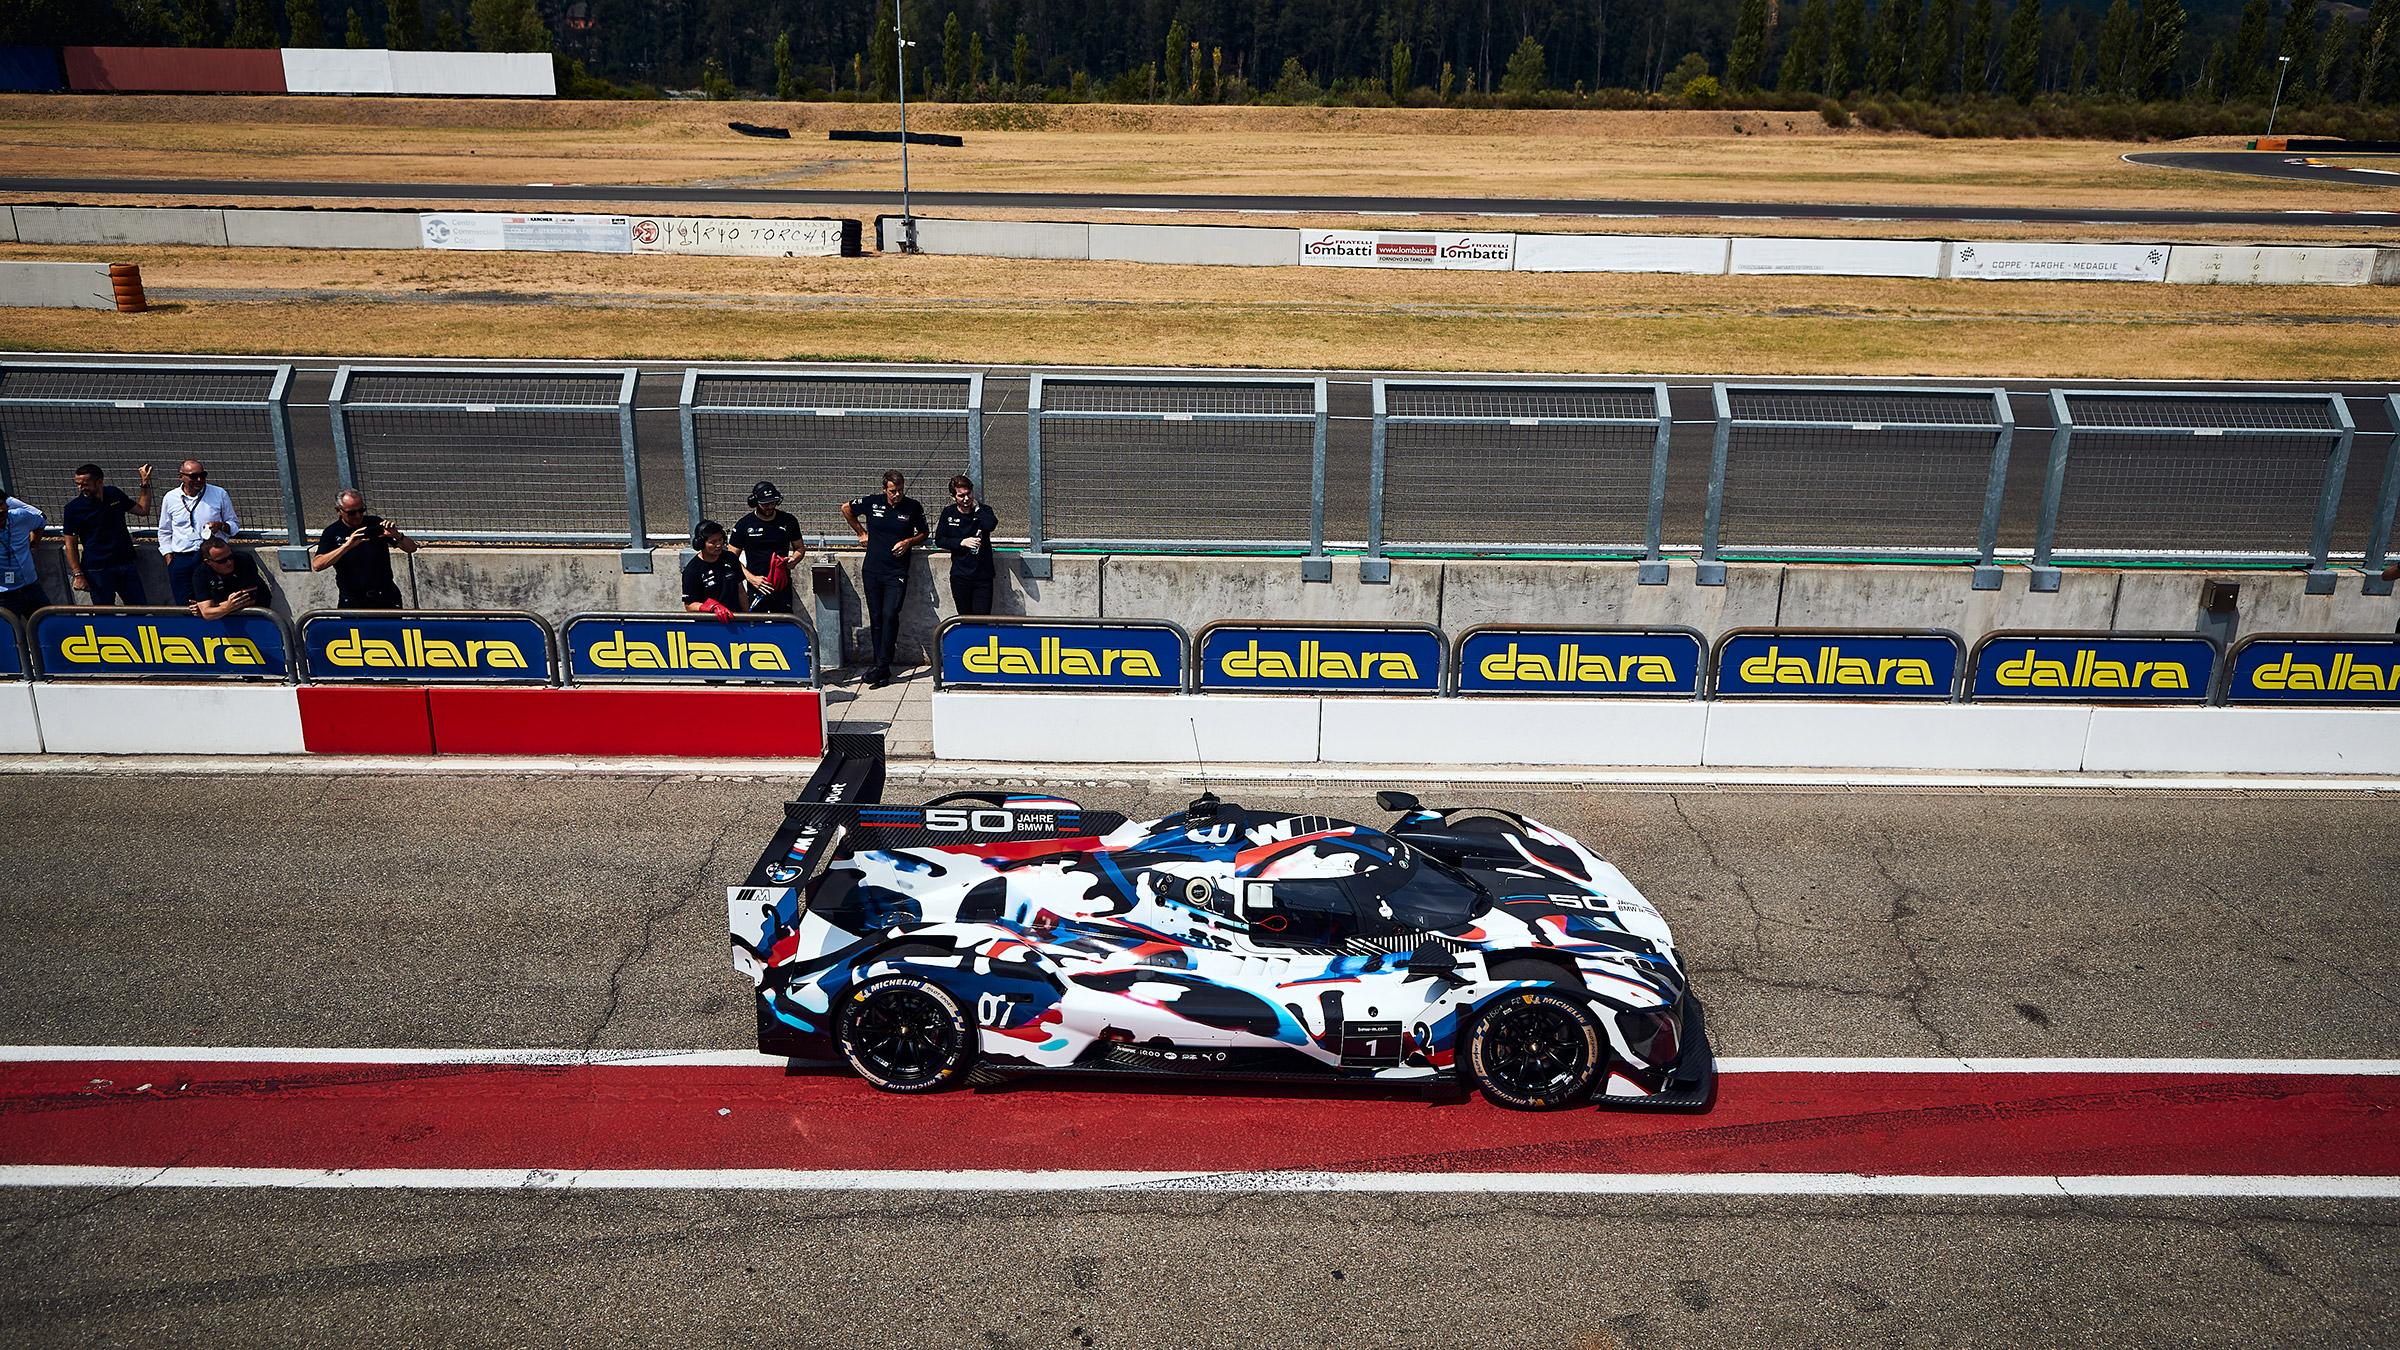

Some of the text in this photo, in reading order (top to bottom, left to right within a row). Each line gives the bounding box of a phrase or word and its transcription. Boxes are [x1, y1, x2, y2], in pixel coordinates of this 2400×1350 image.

[452, 228, 500, 236] Commerciale
[454, 237, 476, 245] Coppi
[1305, 243, 1373, 257] Lombatti
[1379, 246, 1435, 255] www.lombatti.it
[1441, 246, 1509, 260] Lombatti
[1992, 261, 2118, 271] COPPE TARGHE MEDAGLIE
[60, 626, 266, 665] dallara
[326, 629, 529, 668] dallara
[589, 631, 791, 671] dallara
[962, 636, 1160, 676] dallara
[1221, 640, 1419, 680] dallara
[1480, 643, 1677, 683] dallara
[1740, 647, 1934, 686] dallara
[1995, 650, 2190, 689] dallara
[2252, 652, 2400, 691] dallar
[925, 809, 1014, 833] 50
[1017, 814, 1054, 823] JAHRE
[1017, 823, 1054, 832] BMW M
[1547, 893, 1616, 912] 50
[870, 978, 921, 992] MICHELIN
[1542, 996, 1587, 1024] MICHELIN
[1365, 1039, 1378, 1057] 1
[1482, 1079, 1527, 1105] MICHELIN
